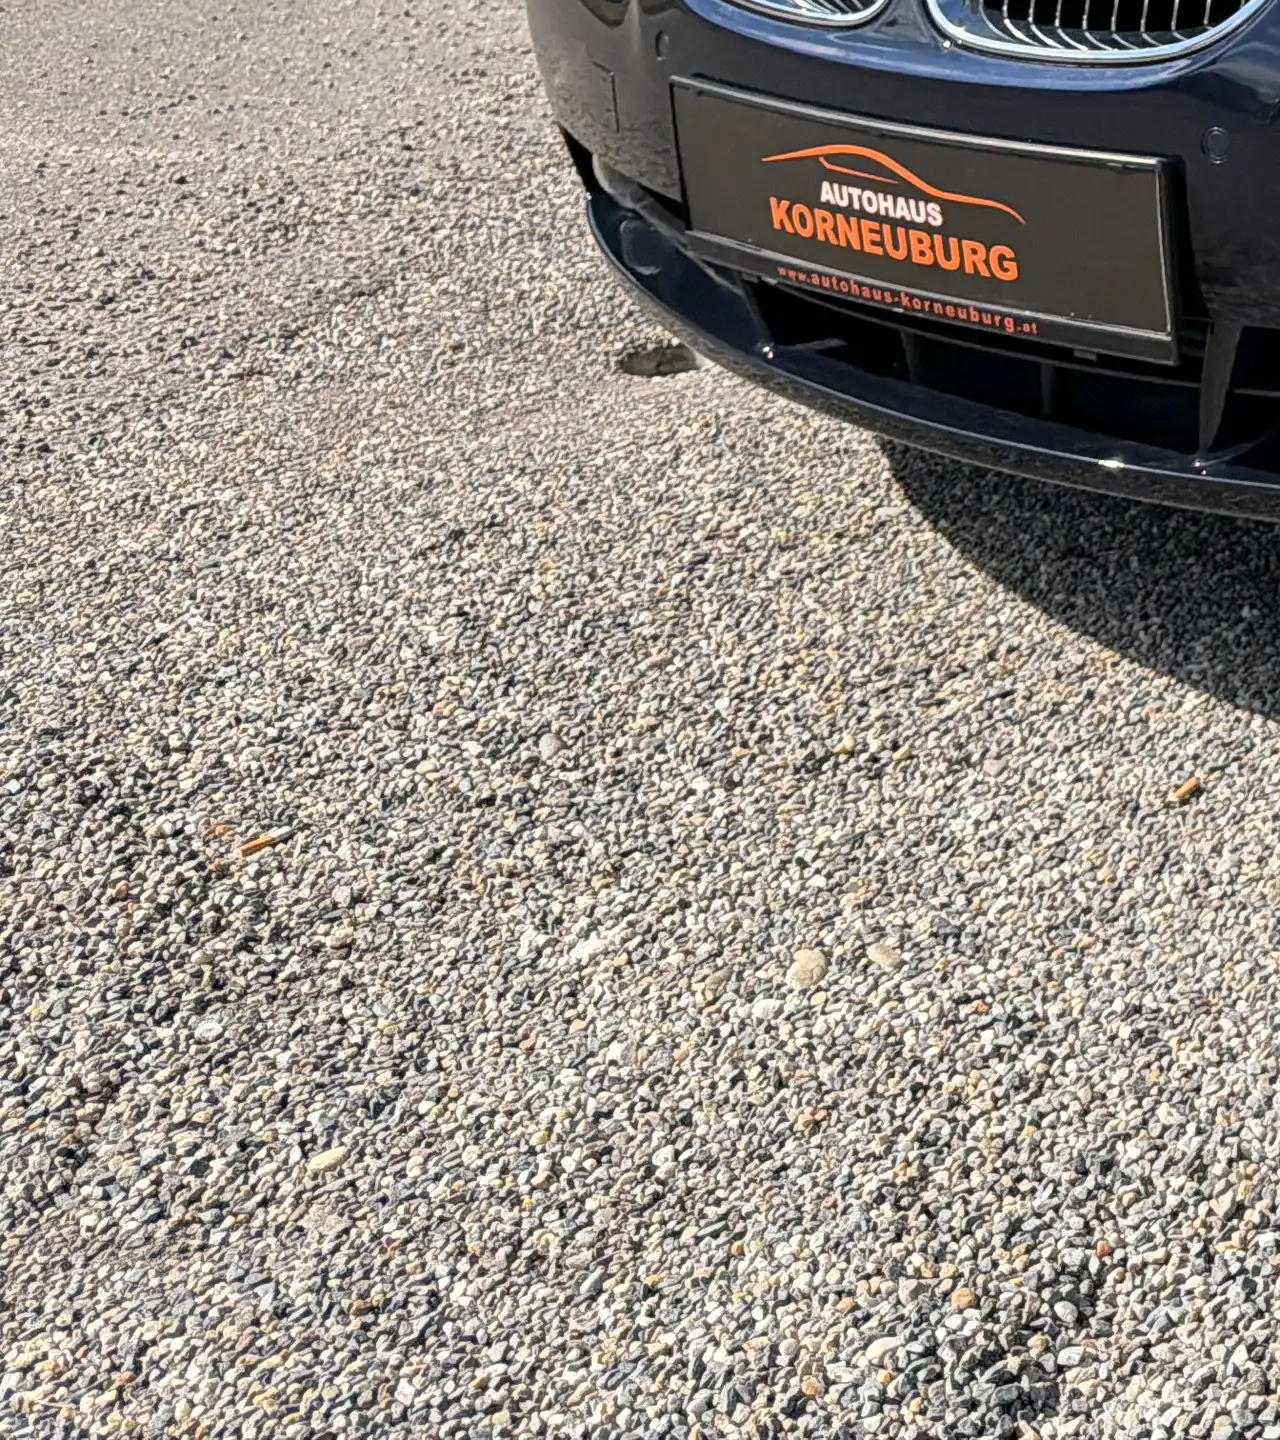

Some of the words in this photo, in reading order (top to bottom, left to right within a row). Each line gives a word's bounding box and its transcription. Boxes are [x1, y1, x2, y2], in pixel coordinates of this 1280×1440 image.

[769, 196, 1019, 282] KORNEUBURG
[820, 180, 943, 227] AUTOHAUS
[776, 265, 1039, 336] www.autohaus-korneuburg.at
